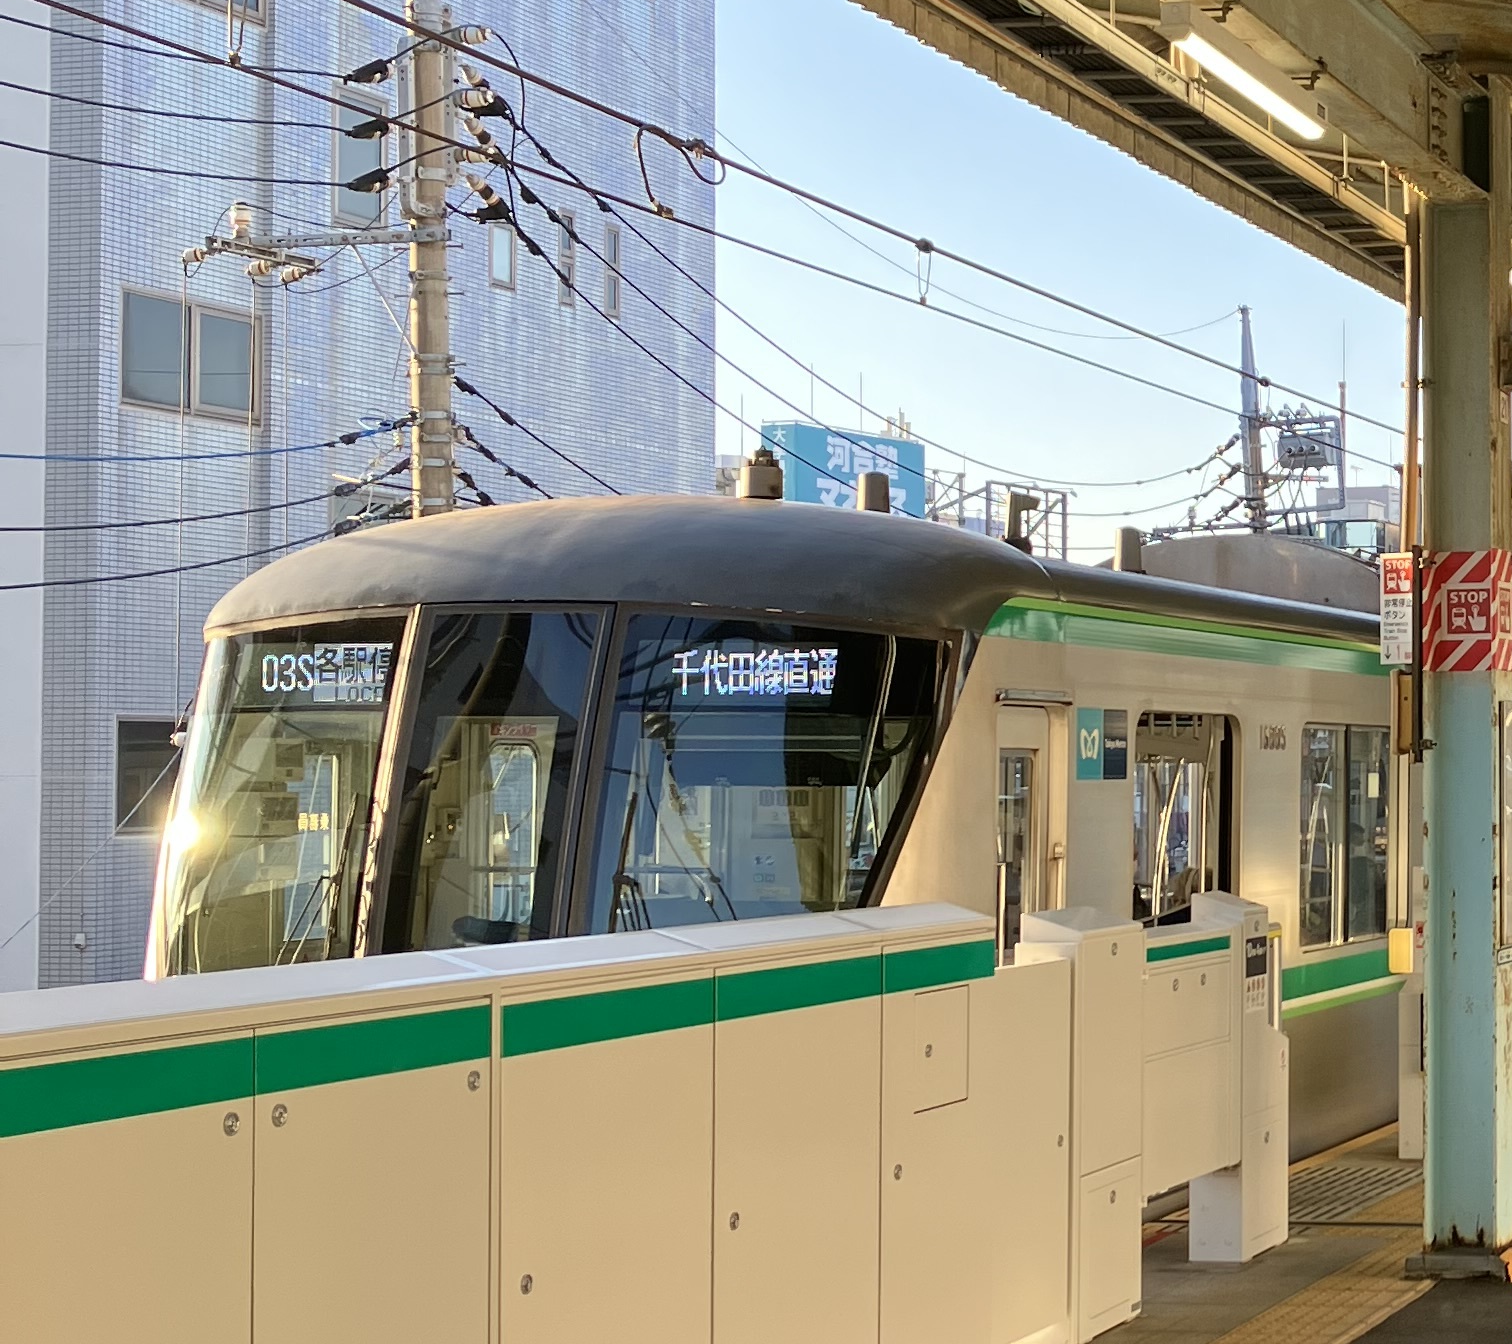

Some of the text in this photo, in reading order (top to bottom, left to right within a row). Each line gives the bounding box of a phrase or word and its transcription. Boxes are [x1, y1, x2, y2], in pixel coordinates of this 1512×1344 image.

[827, 435, 899, 480] 河合塾
[1384, 610, 1406, 620] ボタン
[1449, 591, 1488, 603] STOP
[262, 654, 314, 692] 03S
[672, 648, 838, 695] 千代田線直通
